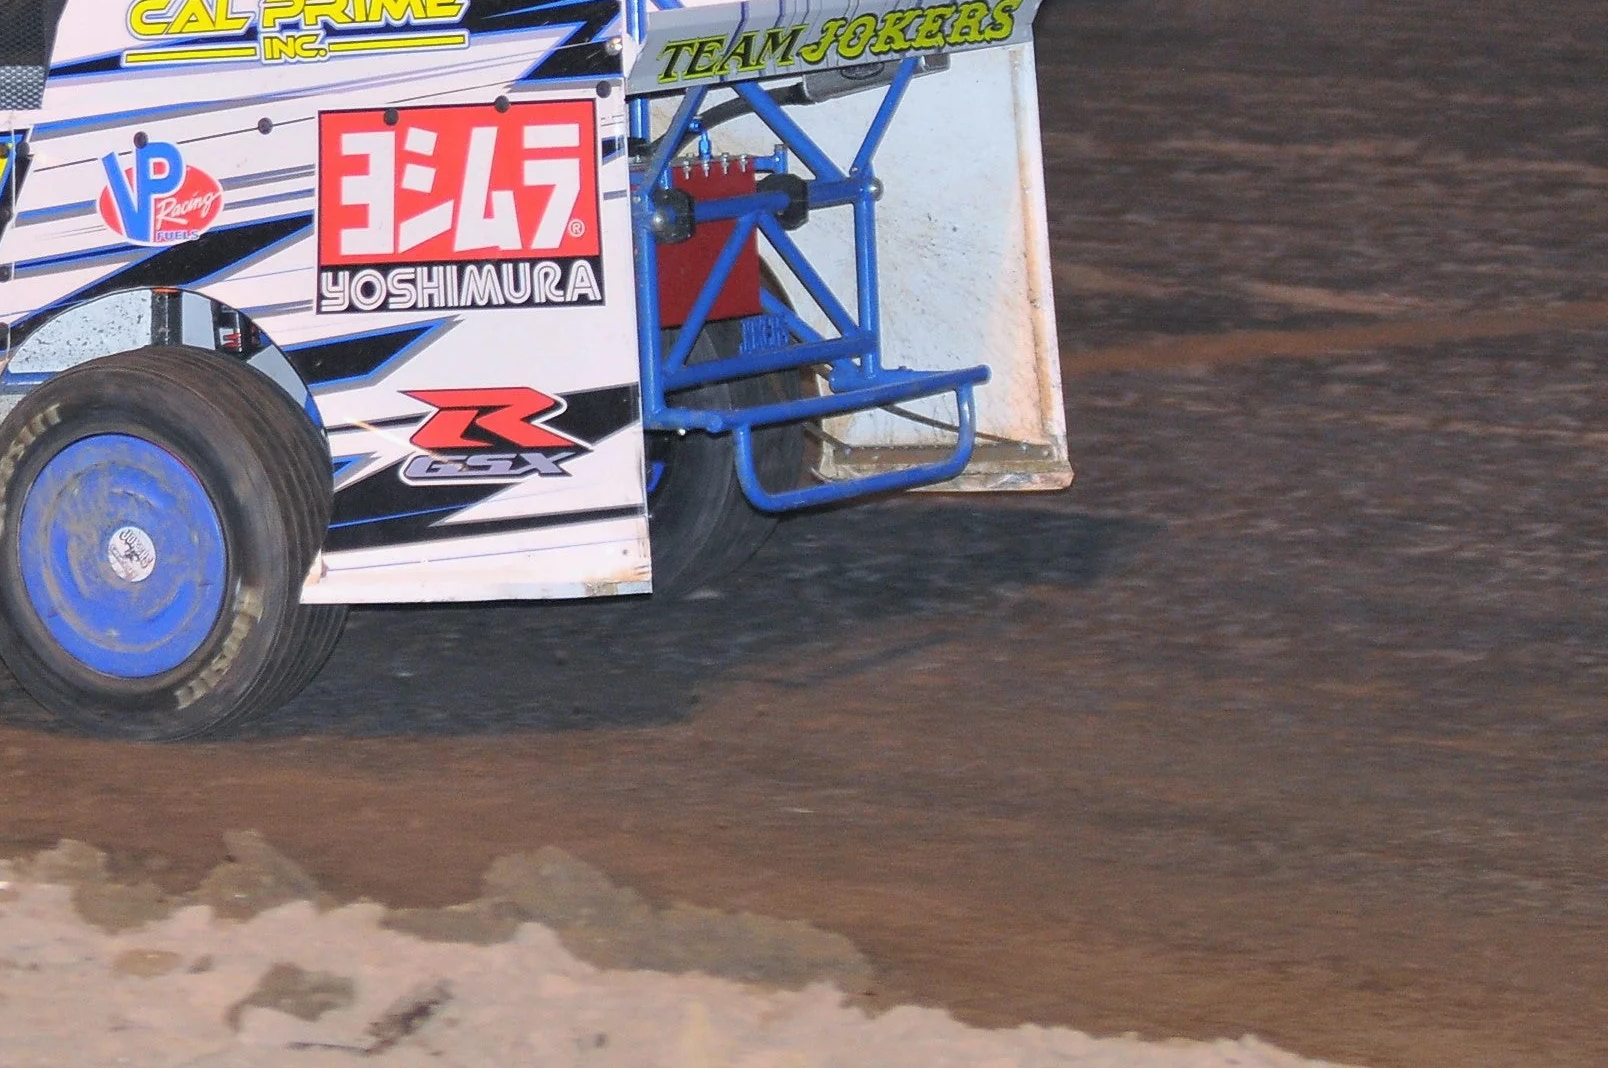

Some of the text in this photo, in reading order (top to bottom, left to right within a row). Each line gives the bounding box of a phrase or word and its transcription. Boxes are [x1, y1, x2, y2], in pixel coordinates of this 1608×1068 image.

[264, 33, 328, 61] INC.
[656, 25, 808, 84] TEAM
[102, 141, 183, 243] VP
[155, 190, 222, 231] Racing
[339, 122, 581, 257] ヨシムラ
[321, 260, 602, 312] YOSHIMURA
[405, 451, 576, 478] GSX
